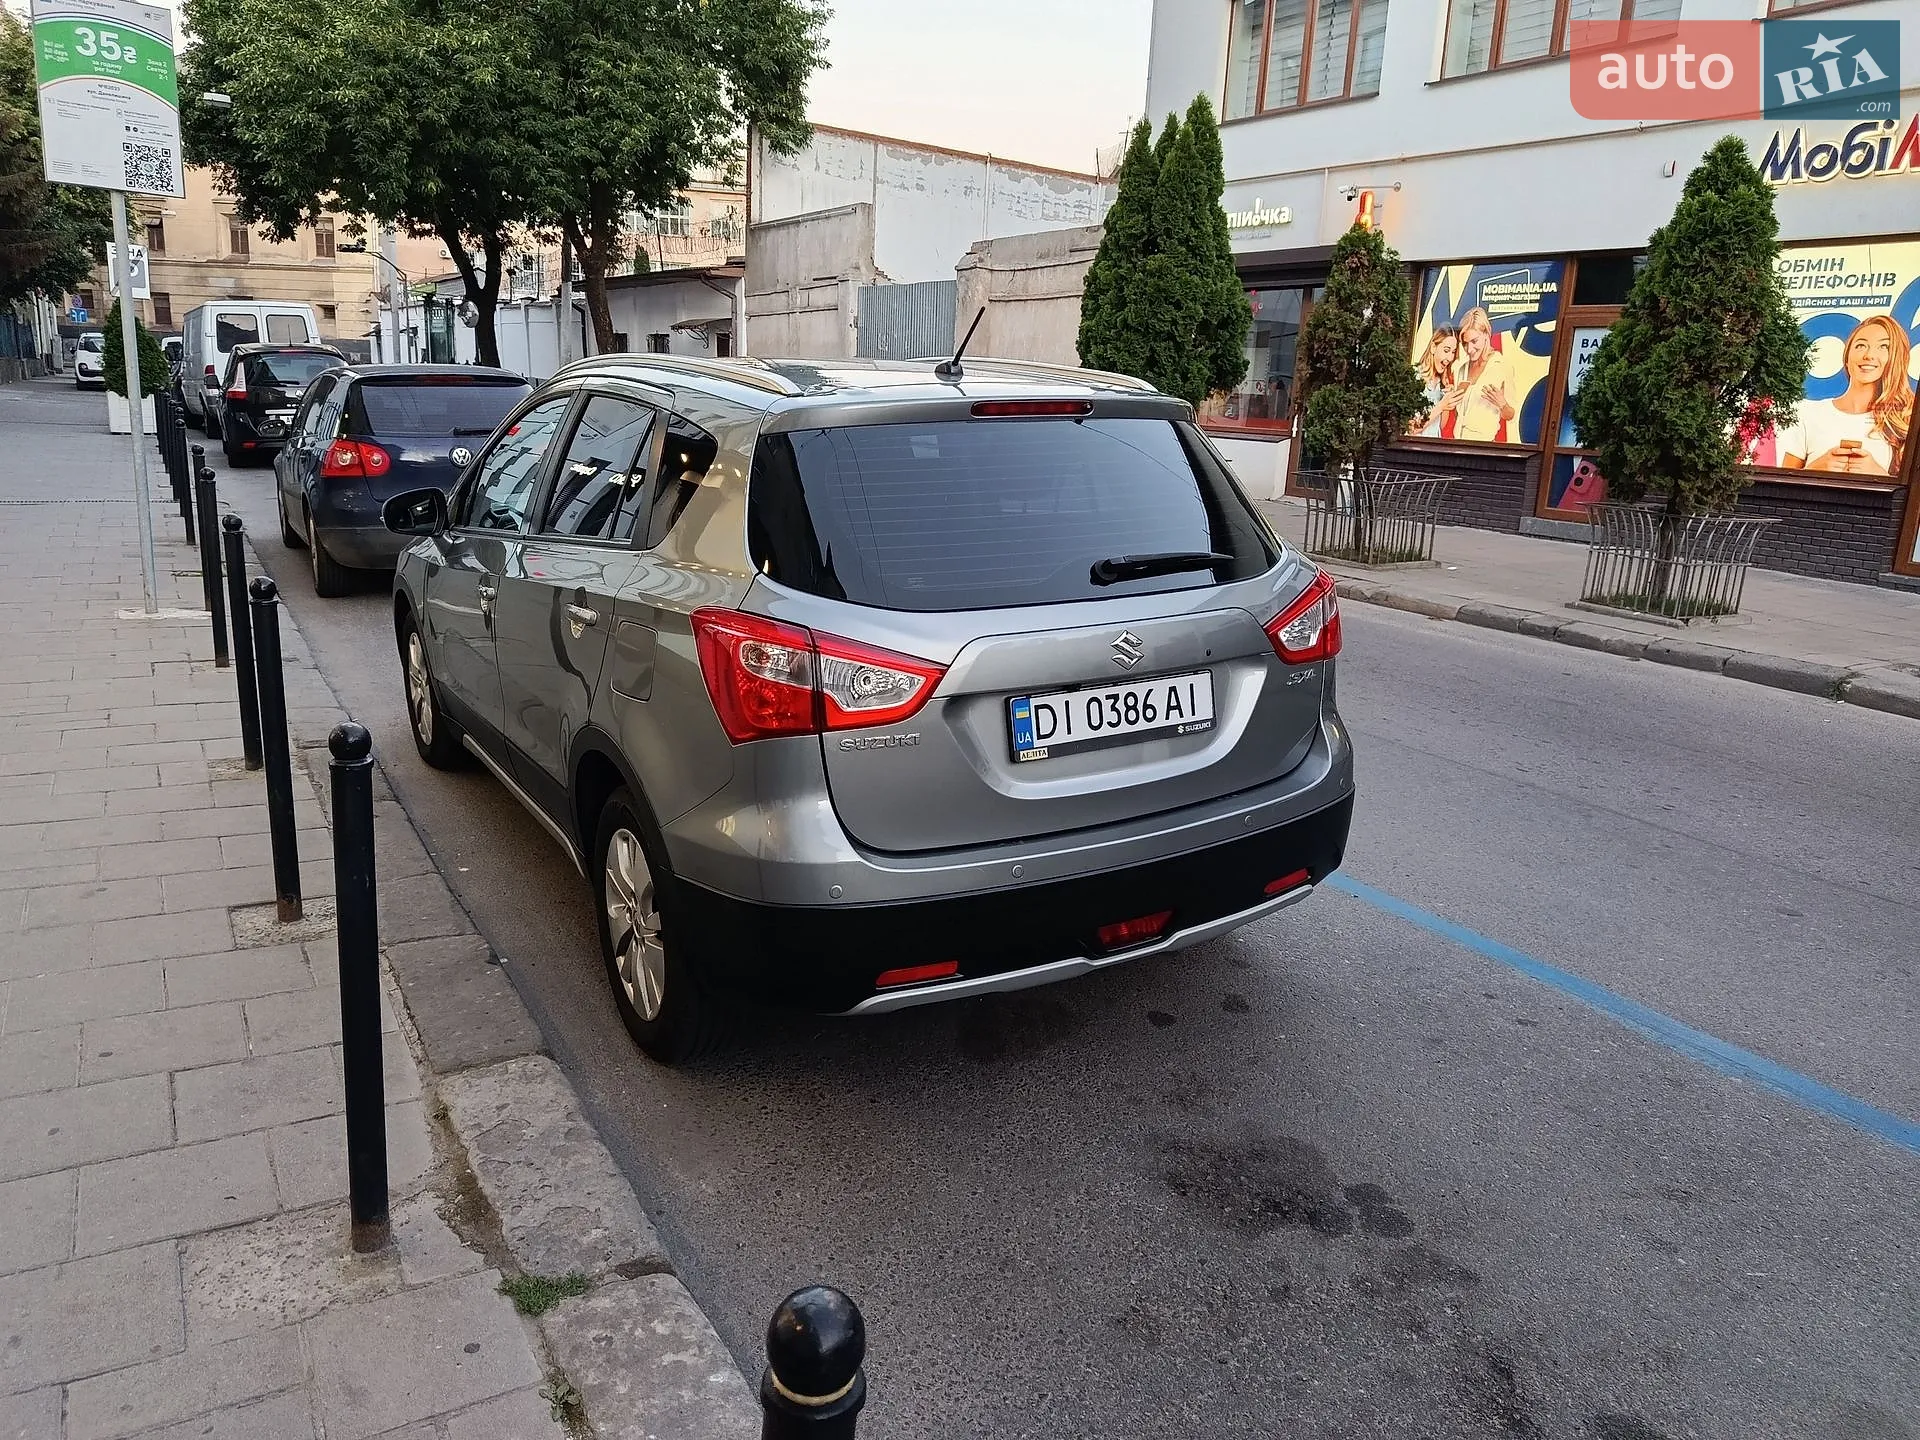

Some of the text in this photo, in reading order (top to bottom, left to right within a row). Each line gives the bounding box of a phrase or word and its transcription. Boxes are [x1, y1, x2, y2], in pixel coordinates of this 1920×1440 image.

[146, 58, 162, 67] Зона
[146, 65, 168, 75] Сектор
[111, 245, 144, 258] ЗНА
[1778, 257, 1845, 273] ОБМІН
[1482, 282, 1558, 295] MOBIMANIA.UA
[1791, 295, 1888, 308] ЗДІЙСНЮЄ ВАШІ МРІЇ
[1034, 682, 1197, 741] DI 0386 AI
[1185, 721, 1211, 732] SUZUKI
[840, 732, 921, 752] SUZUKI
[1017, 731, 1032, 744] UA
